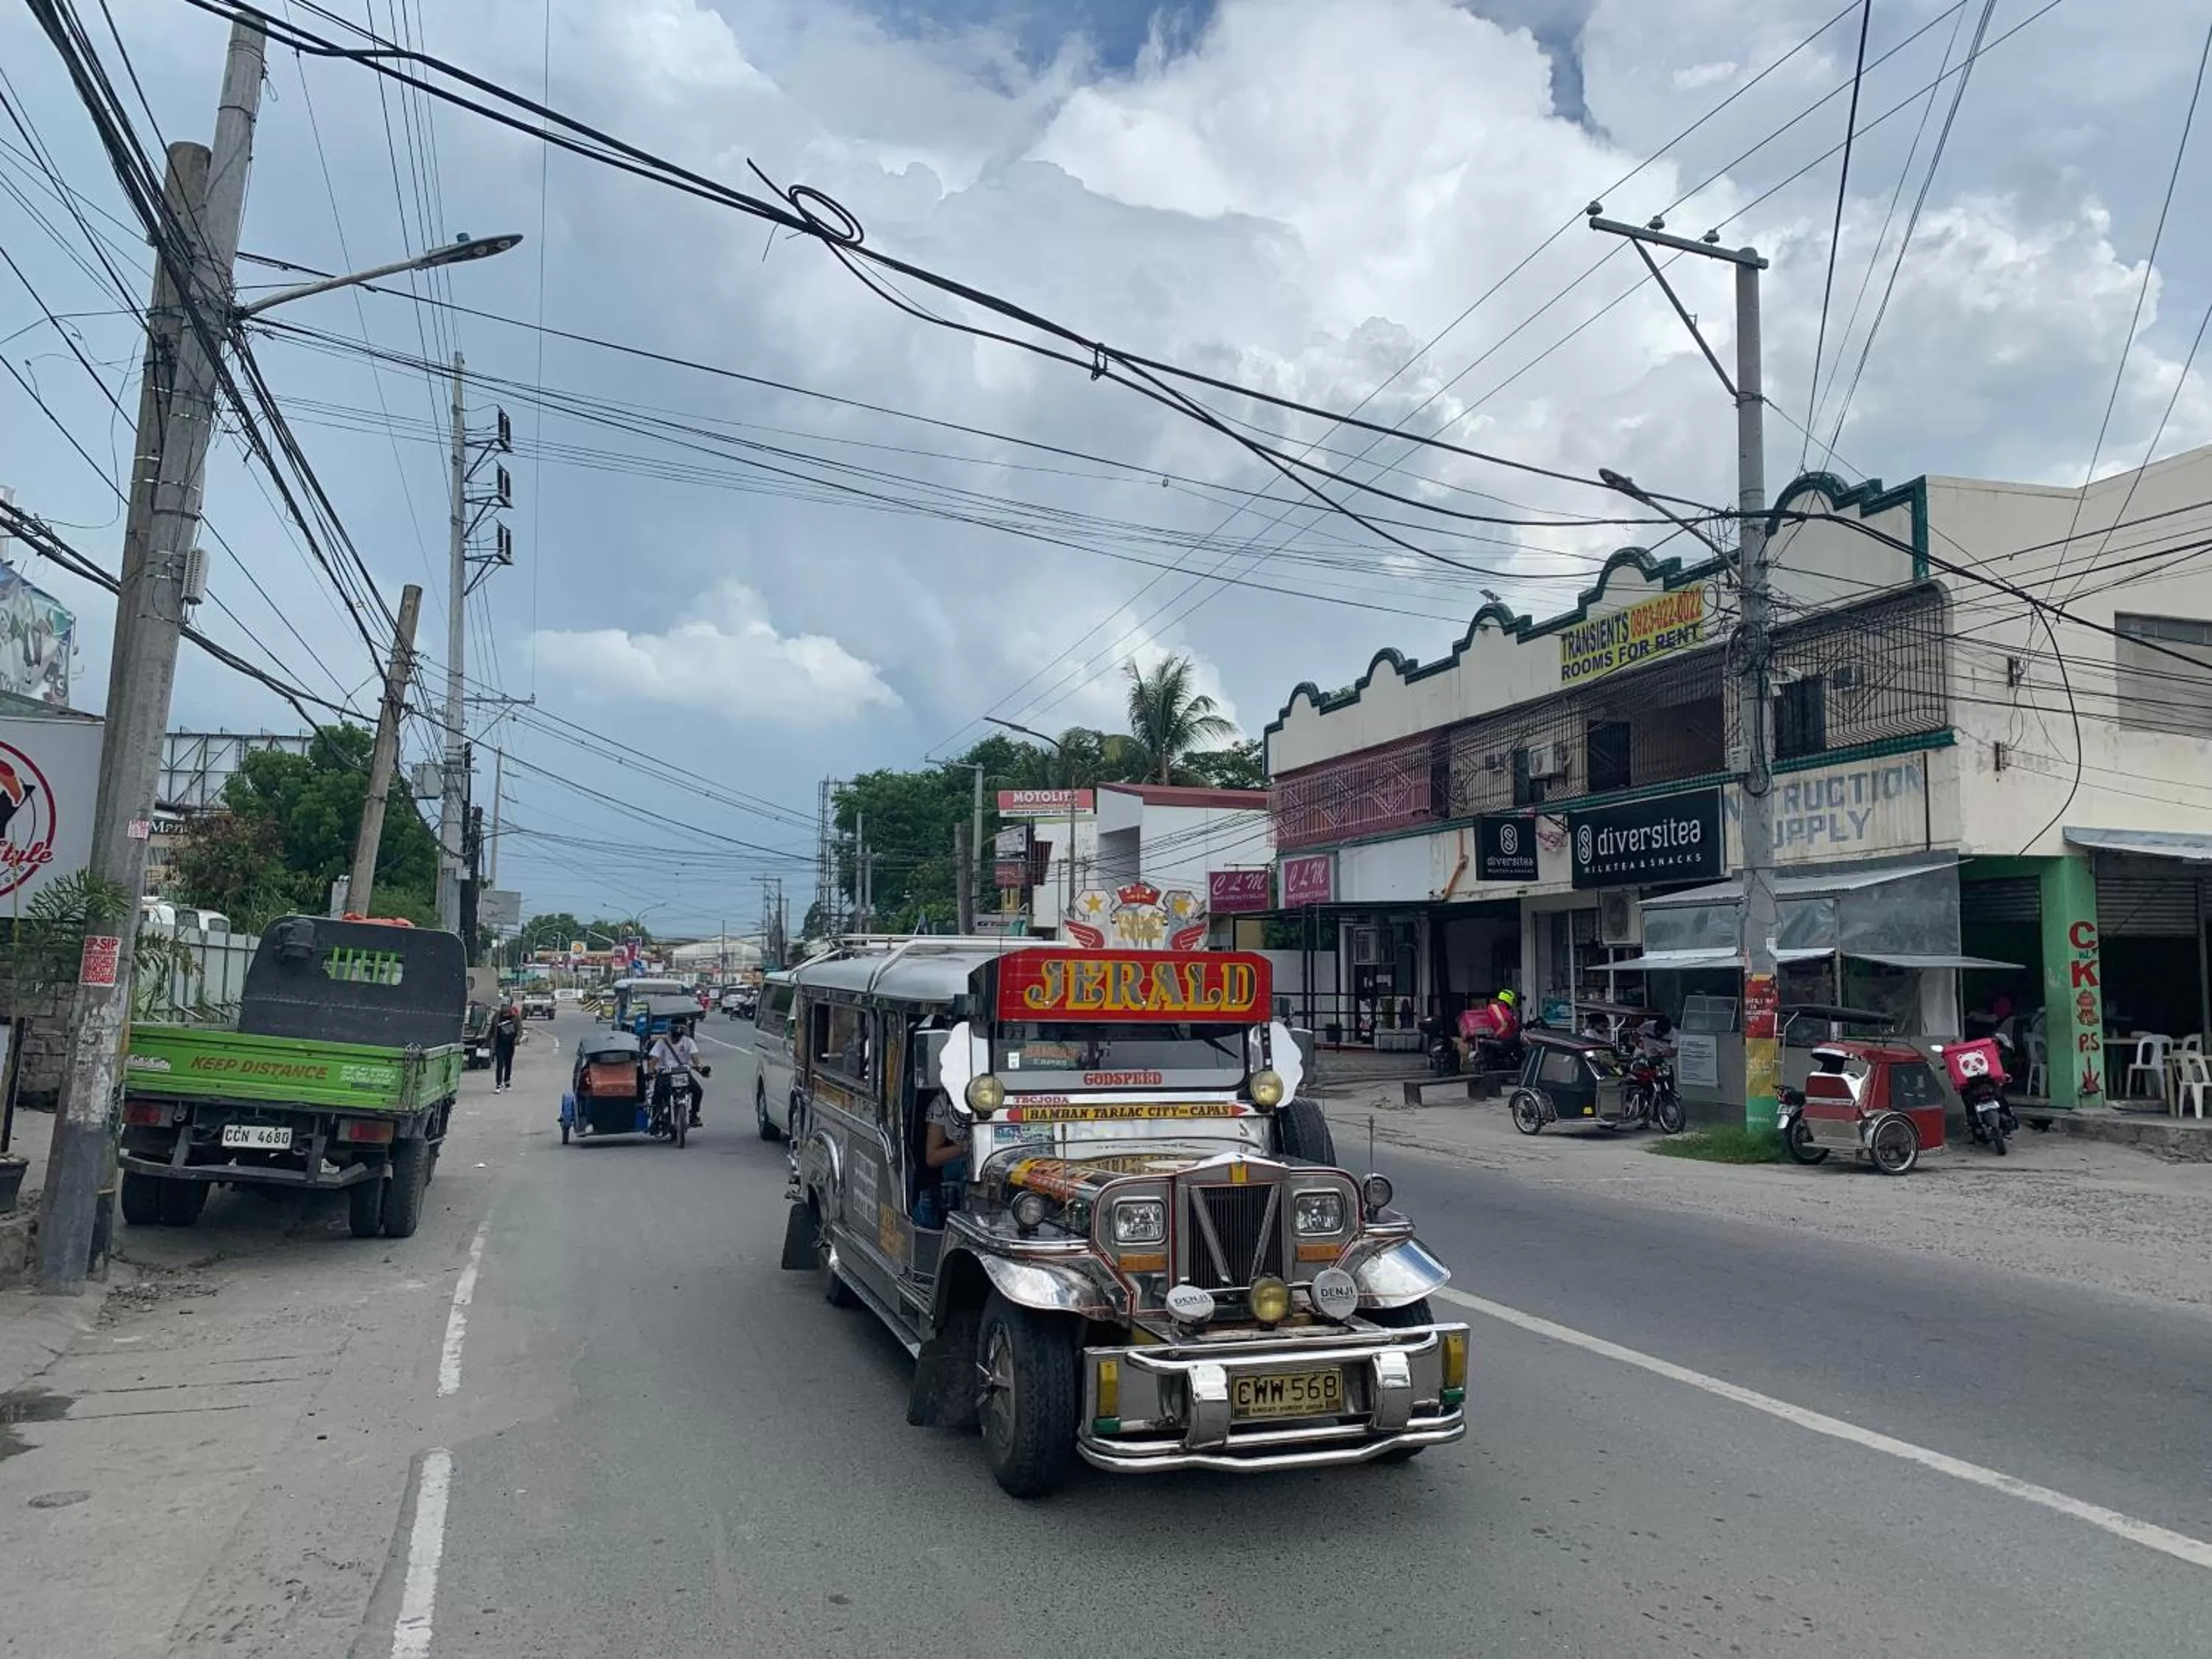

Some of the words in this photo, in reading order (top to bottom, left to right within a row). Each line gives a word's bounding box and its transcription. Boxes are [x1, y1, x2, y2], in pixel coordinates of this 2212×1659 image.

[1561, 612, 1629, 661] TRANSIENTS
[1562, 650, 1613, 681] ROOMS
[1619, 639, 1649, 664] FOR
[1655, 625, 1697, 650] RENT
[1598, 817, 1701, 856] diversitea
[1584, 860, 1636, 874] MILKTEA
[1649, 852, 1702, 867] SNACKS
[2069, 920, 2096, 949] C
[1023, 959, 1256, 1012] JERALD
[2070, 960, 2099, 989] K
[192, 1056, 237, 1071] KEEP
[240, 1060, 328, 1080] DISTANCE
[1083, 1071, 1162, 1086] GODSPEED
[1029, 1107, 1088, 1119] BAMBAN
[1093, 1107, 1143, 1119] TARLAC
[1147, 1105, 1180, 1117] CITY
[1189, 1105, 1230, 1116] CAPAS
[225, 1129, 250, 1142] CCN
[257, 1130, 289, 1144] 4680
[1174, 1294, 1208, 1304] DENJI
[1321, 1285, 1354, 1297] DENJI
